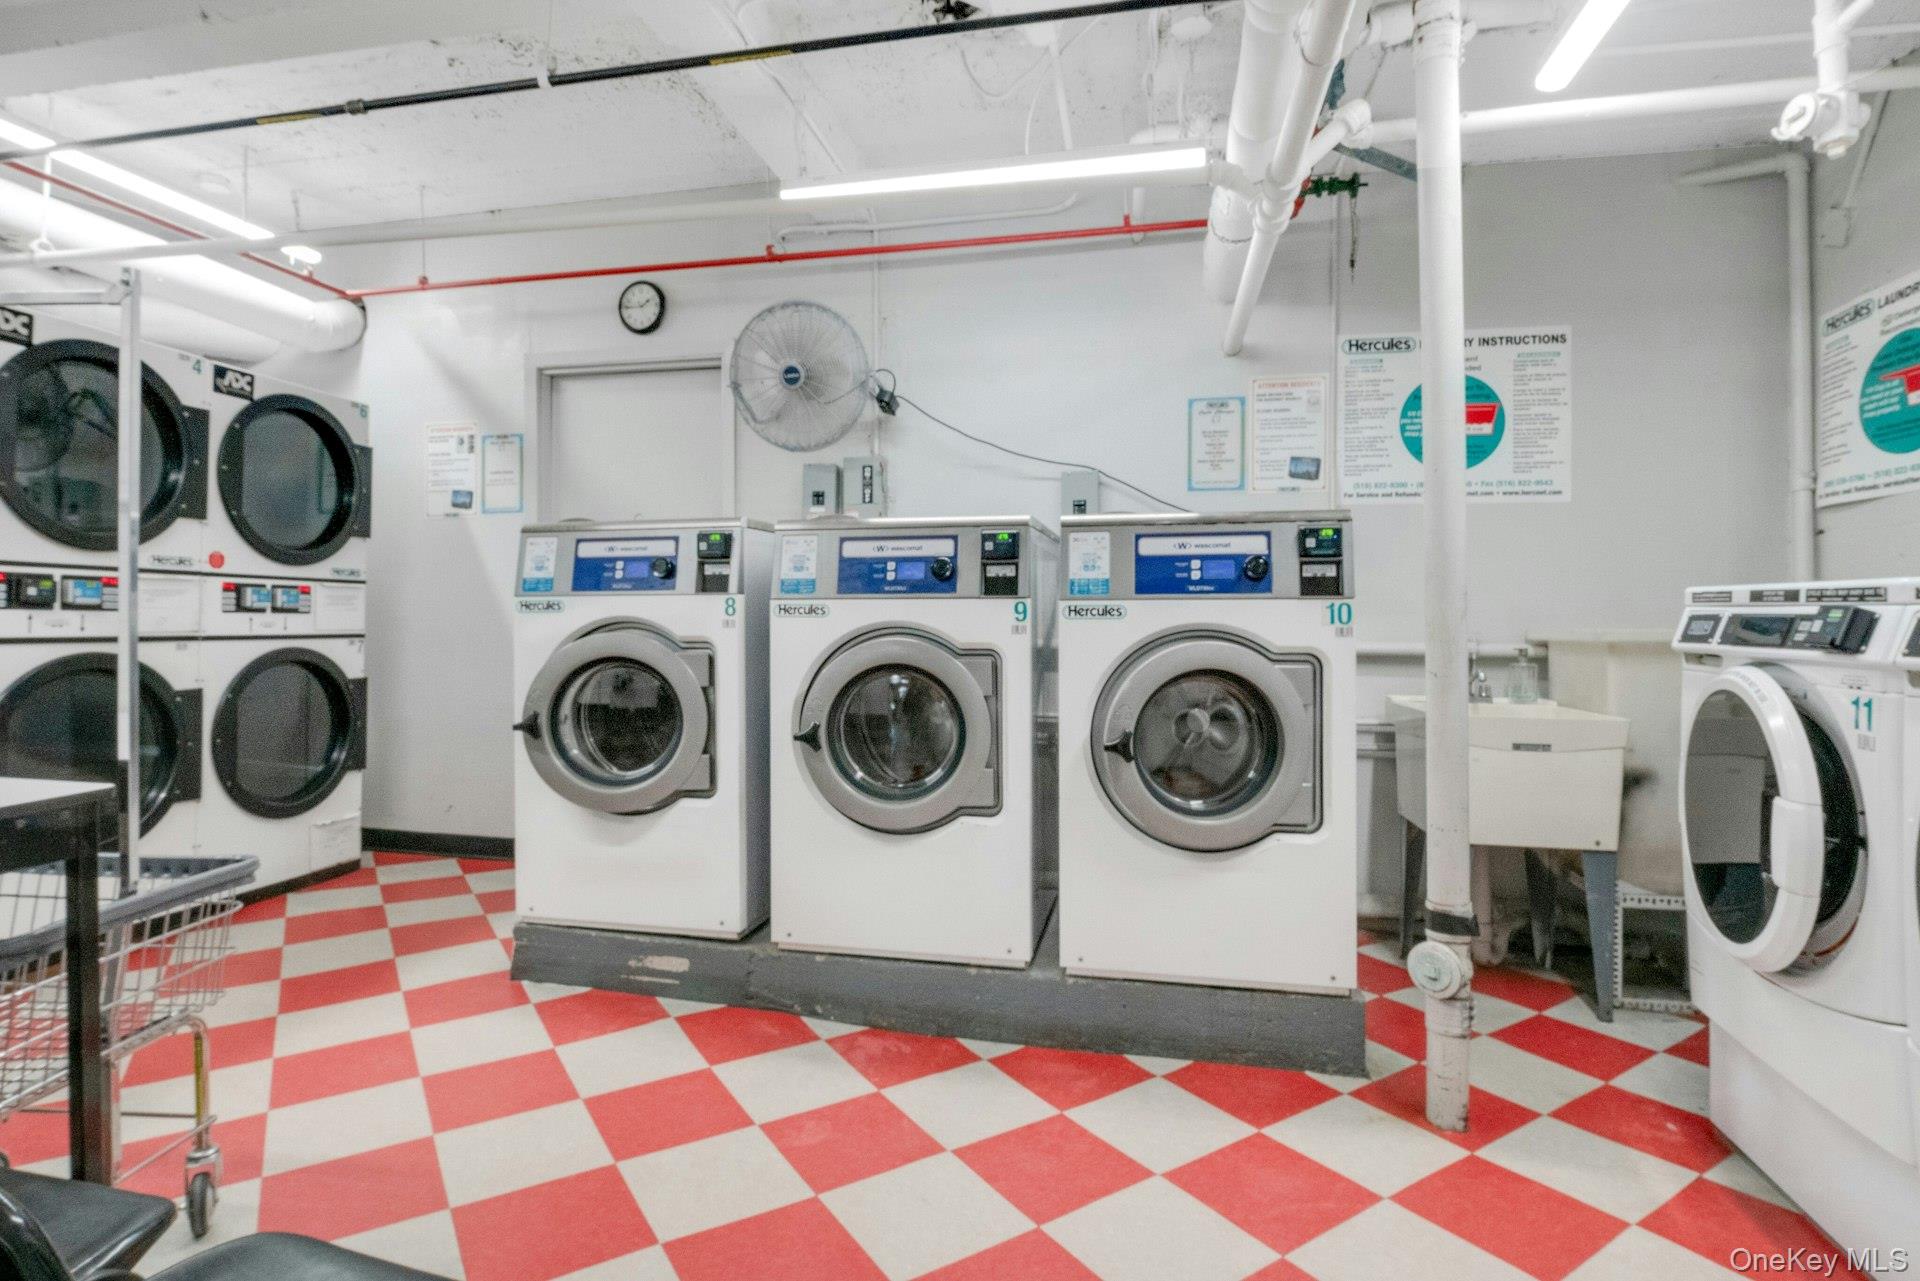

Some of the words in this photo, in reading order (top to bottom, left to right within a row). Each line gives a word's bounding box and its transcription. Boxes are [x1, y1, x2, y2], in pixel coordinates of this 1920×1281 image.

[1877, 281, 1920, 309] LAUNDR
[1348, 338, 1411, 352] Hercules
[1477, 333, 1567, 347] INSTRUCTIONS
[192, 359, 202, 374] 4
[519, 600, 563, 612] Hercules
[724, 598, 736, 617] 8
[777, 604, 826, 617] Hercules
[1014, 601, 1028, 622] 9
[1067, 605, 1123, 618] Hercules
[1326, 602, 1352, 625] 10
[1851, 696, 1872, 732] 11
